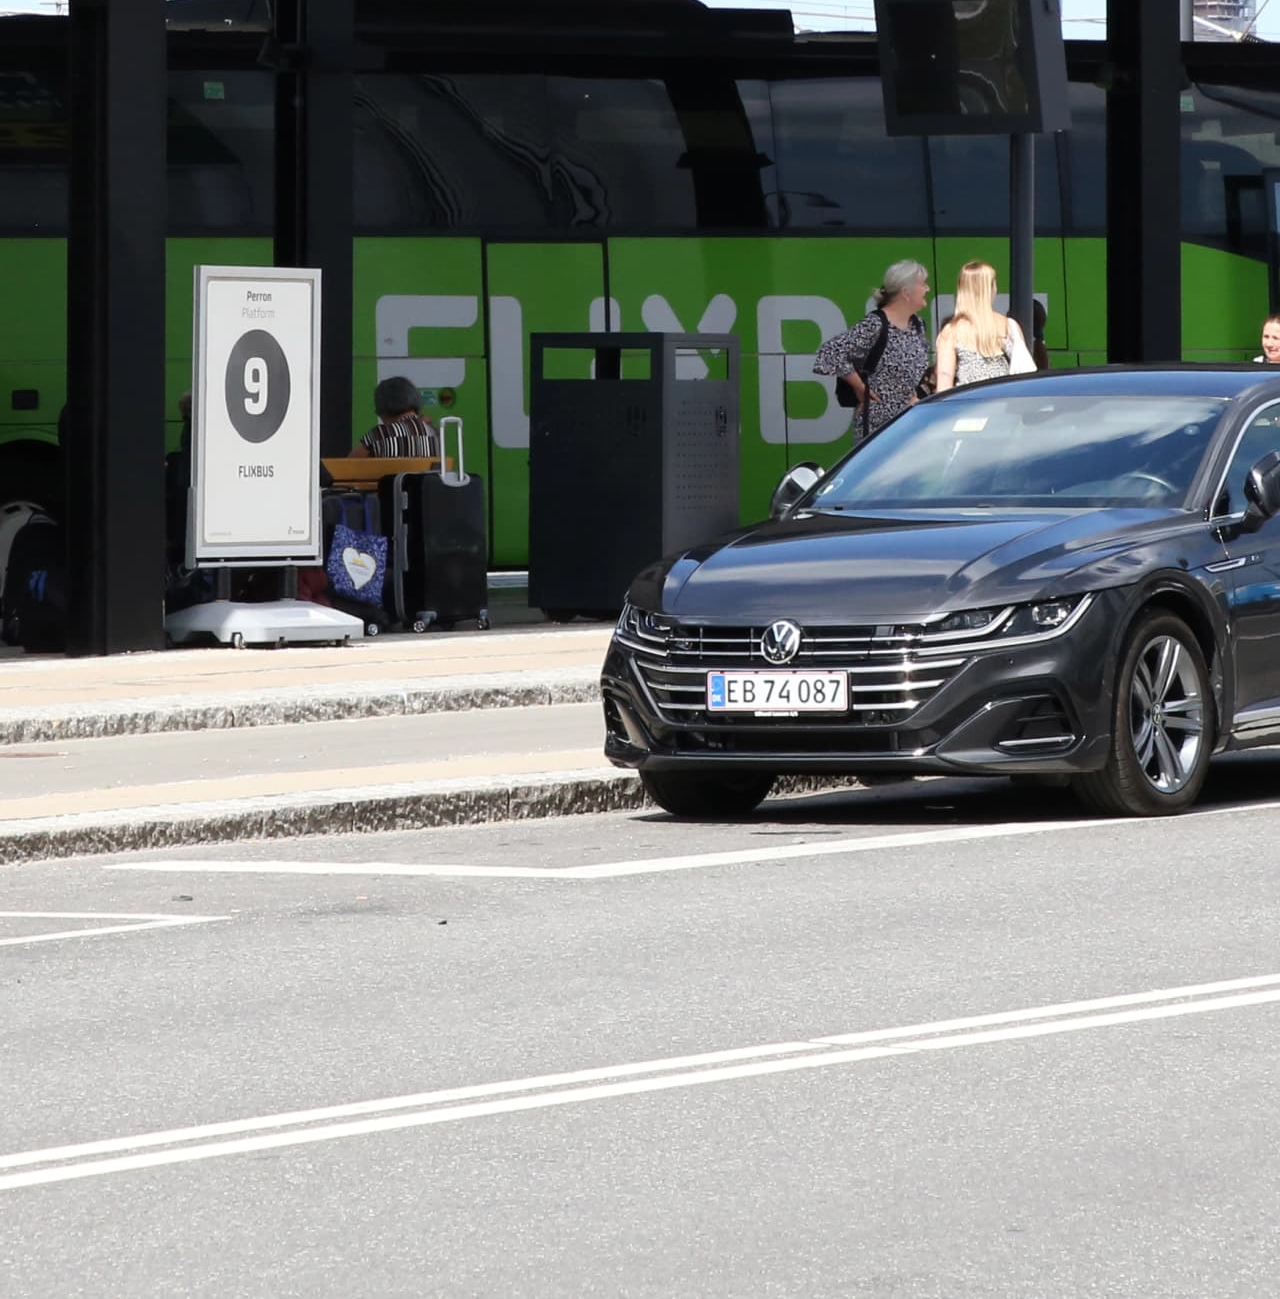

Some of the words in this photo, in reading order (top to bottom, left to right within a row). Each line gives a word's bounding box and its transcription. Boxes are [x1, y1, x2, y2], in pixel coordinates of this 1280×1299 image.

[246, 290, 272, 302] Perron
[241, 306, 275, 319] Platform
[243, 356, 269, 415] 9
[238, 465, 275, 478] FLIXBUS
[727, 679, 756, 703] EB
[763, 679, 791, 703] 74
[798, 679, 841, 703] 087
